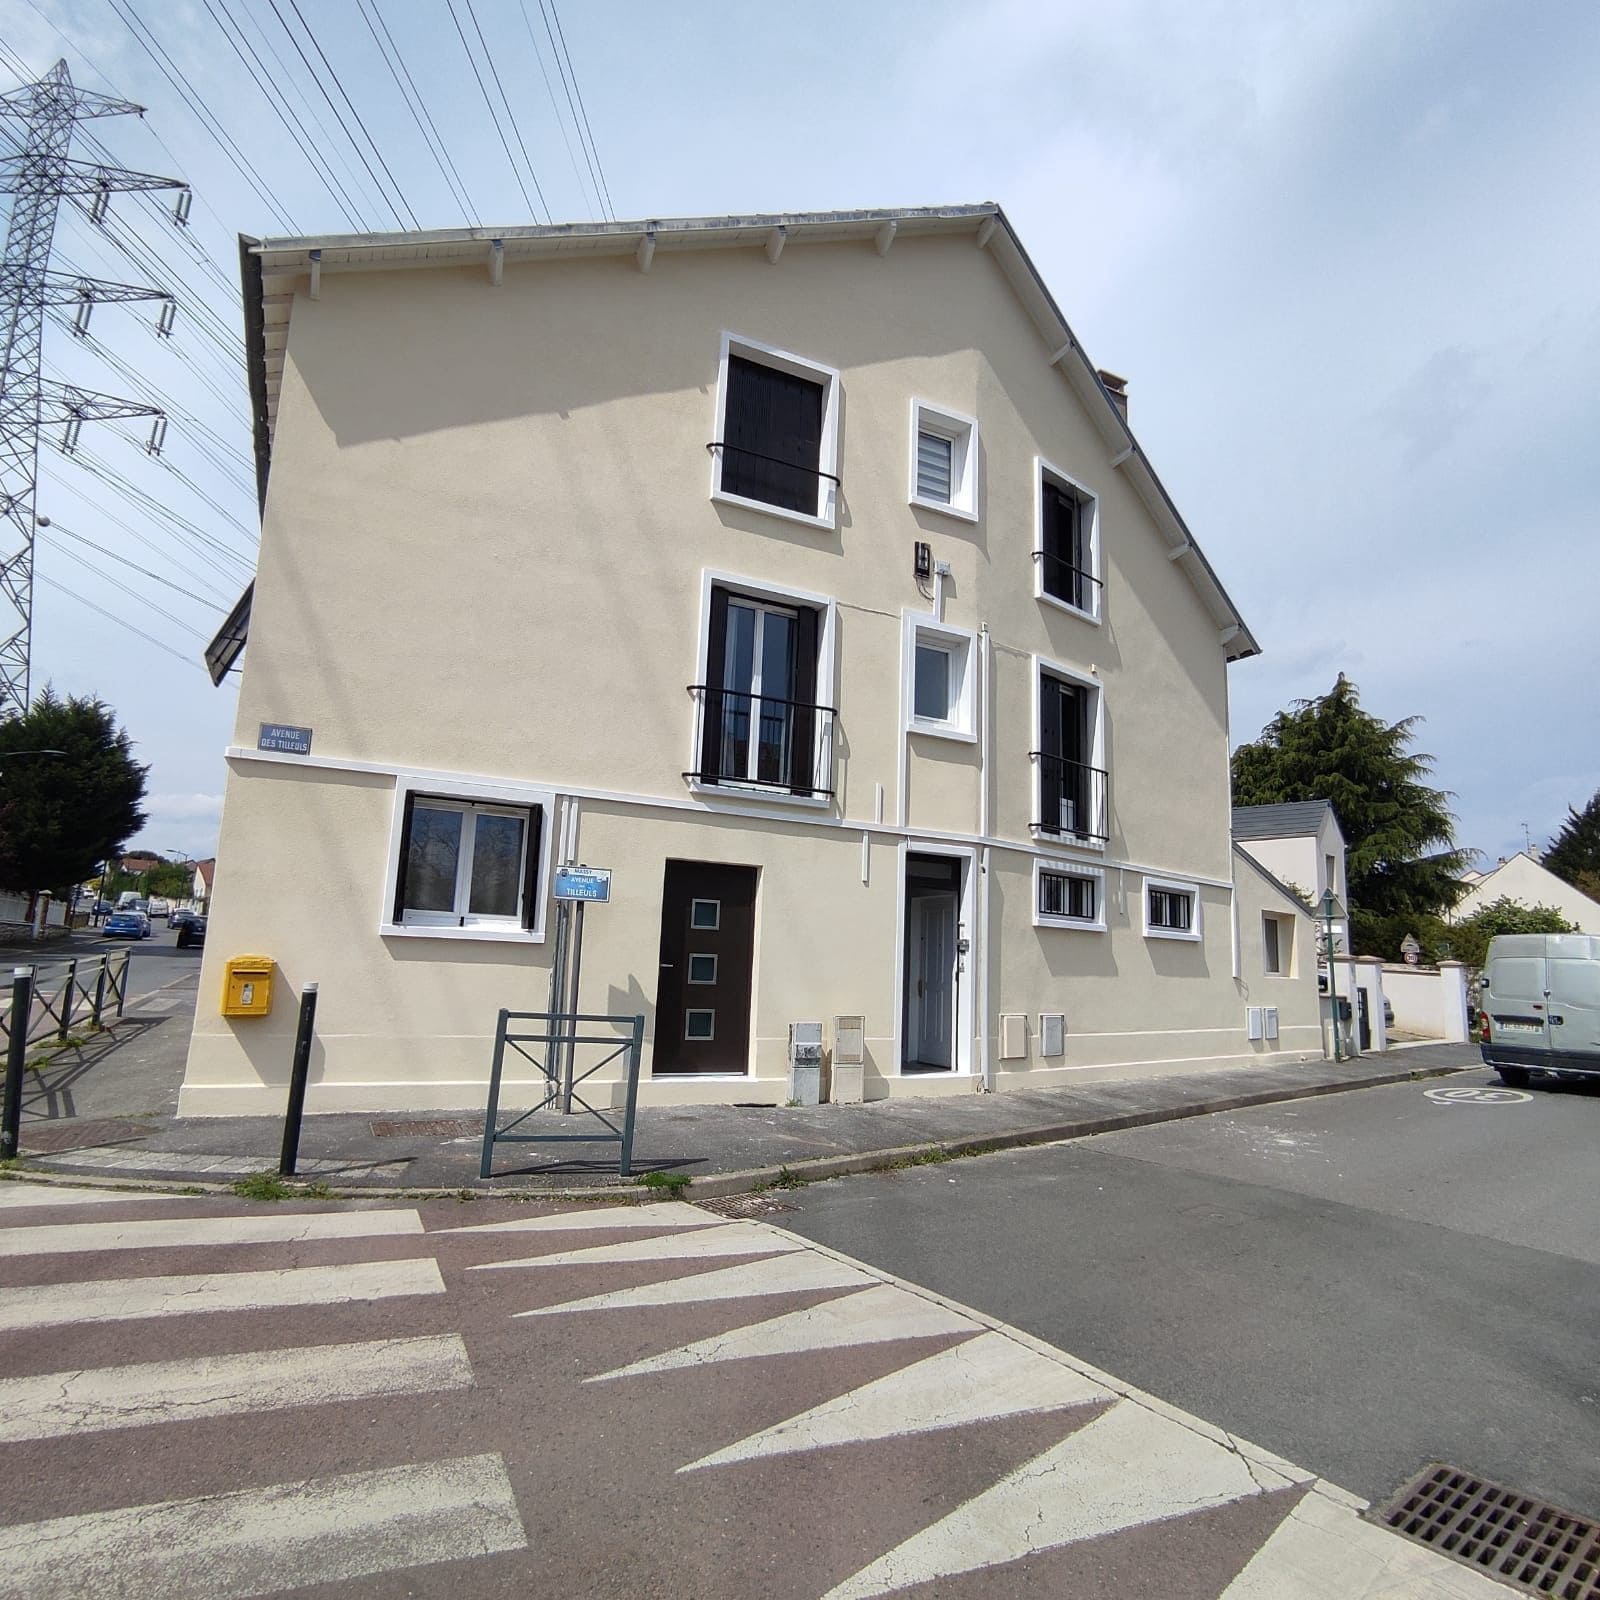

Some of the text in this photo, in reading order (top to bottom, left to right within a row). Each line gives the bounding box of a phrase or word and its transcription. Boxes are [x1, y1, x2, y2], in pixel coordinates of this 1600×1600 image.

[270, 728, 301, 740] AVENUE
[261, 738, 308, 751] DES TILLEULS
[566, 888, 597, 897] TILLEULS
